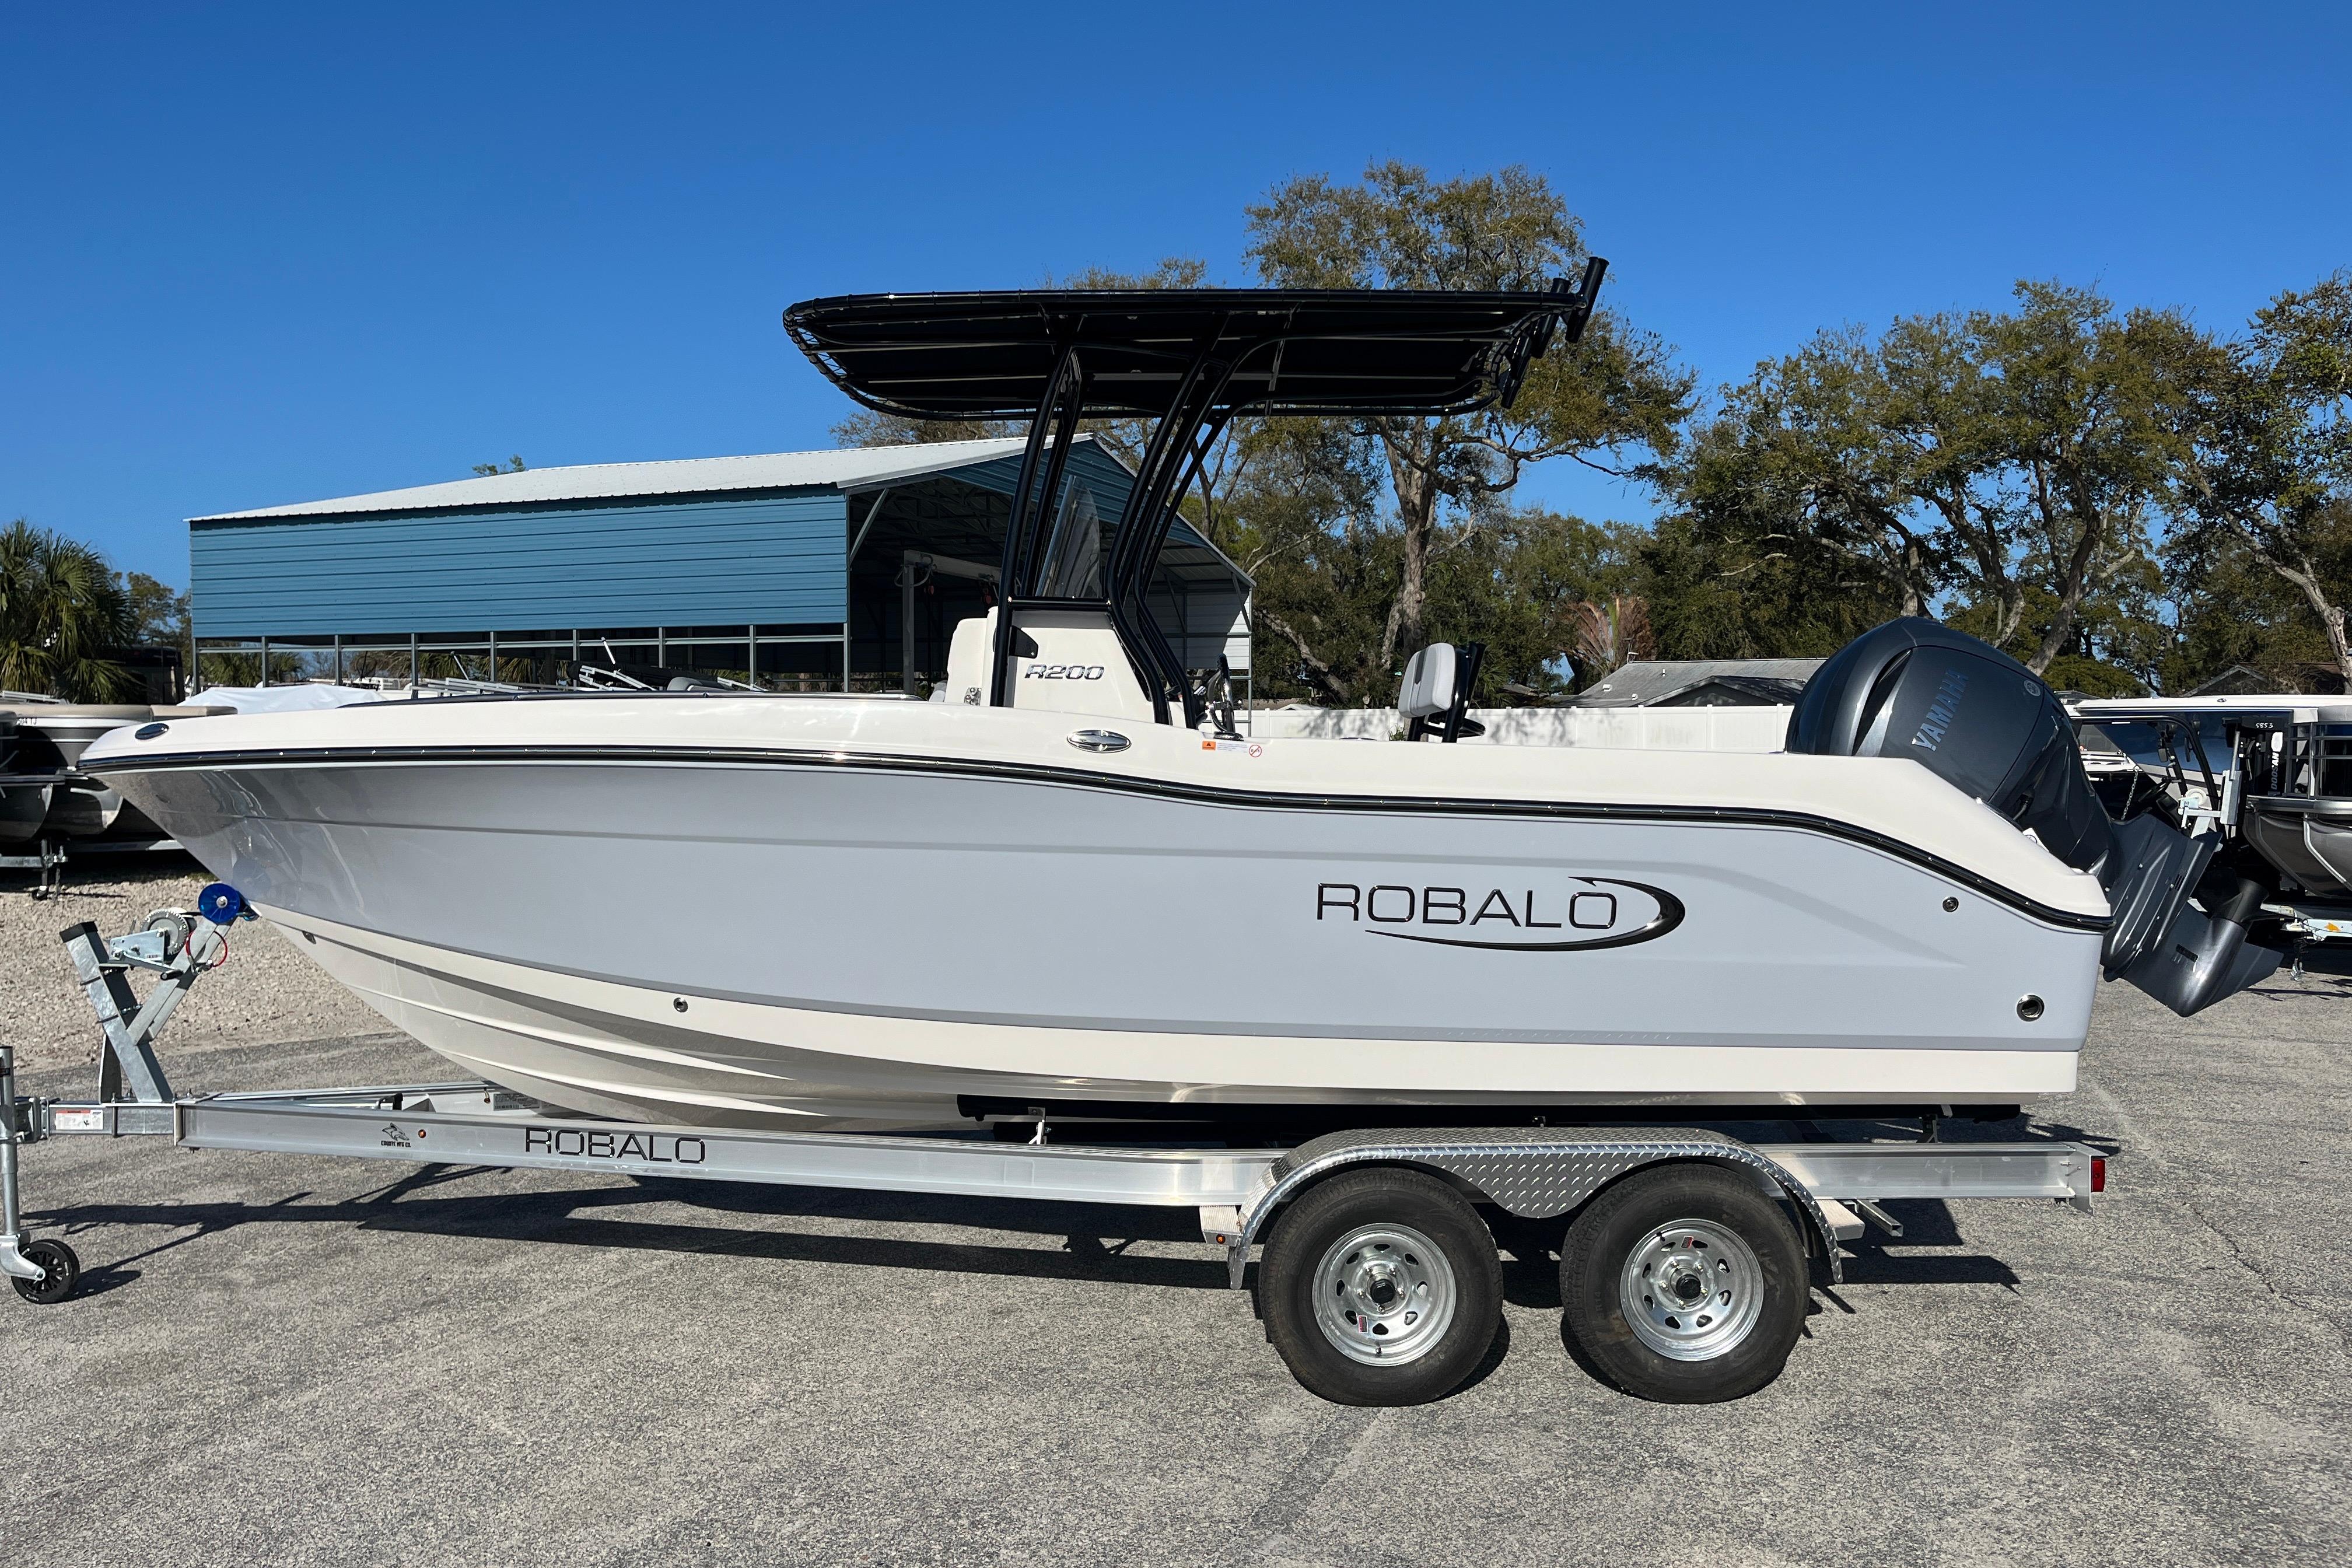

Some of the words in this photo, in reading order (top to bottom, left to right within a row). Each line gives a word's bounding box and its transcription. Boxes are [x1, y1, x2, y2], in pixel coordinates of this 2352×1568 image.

[1025, 664, 1105, 680] R200
[1912, 668, 1969, 751] YAMAHA
[1317, 883, 1617, 930] ROBALO
[526, 1126, 705, 1164] ROBALO
